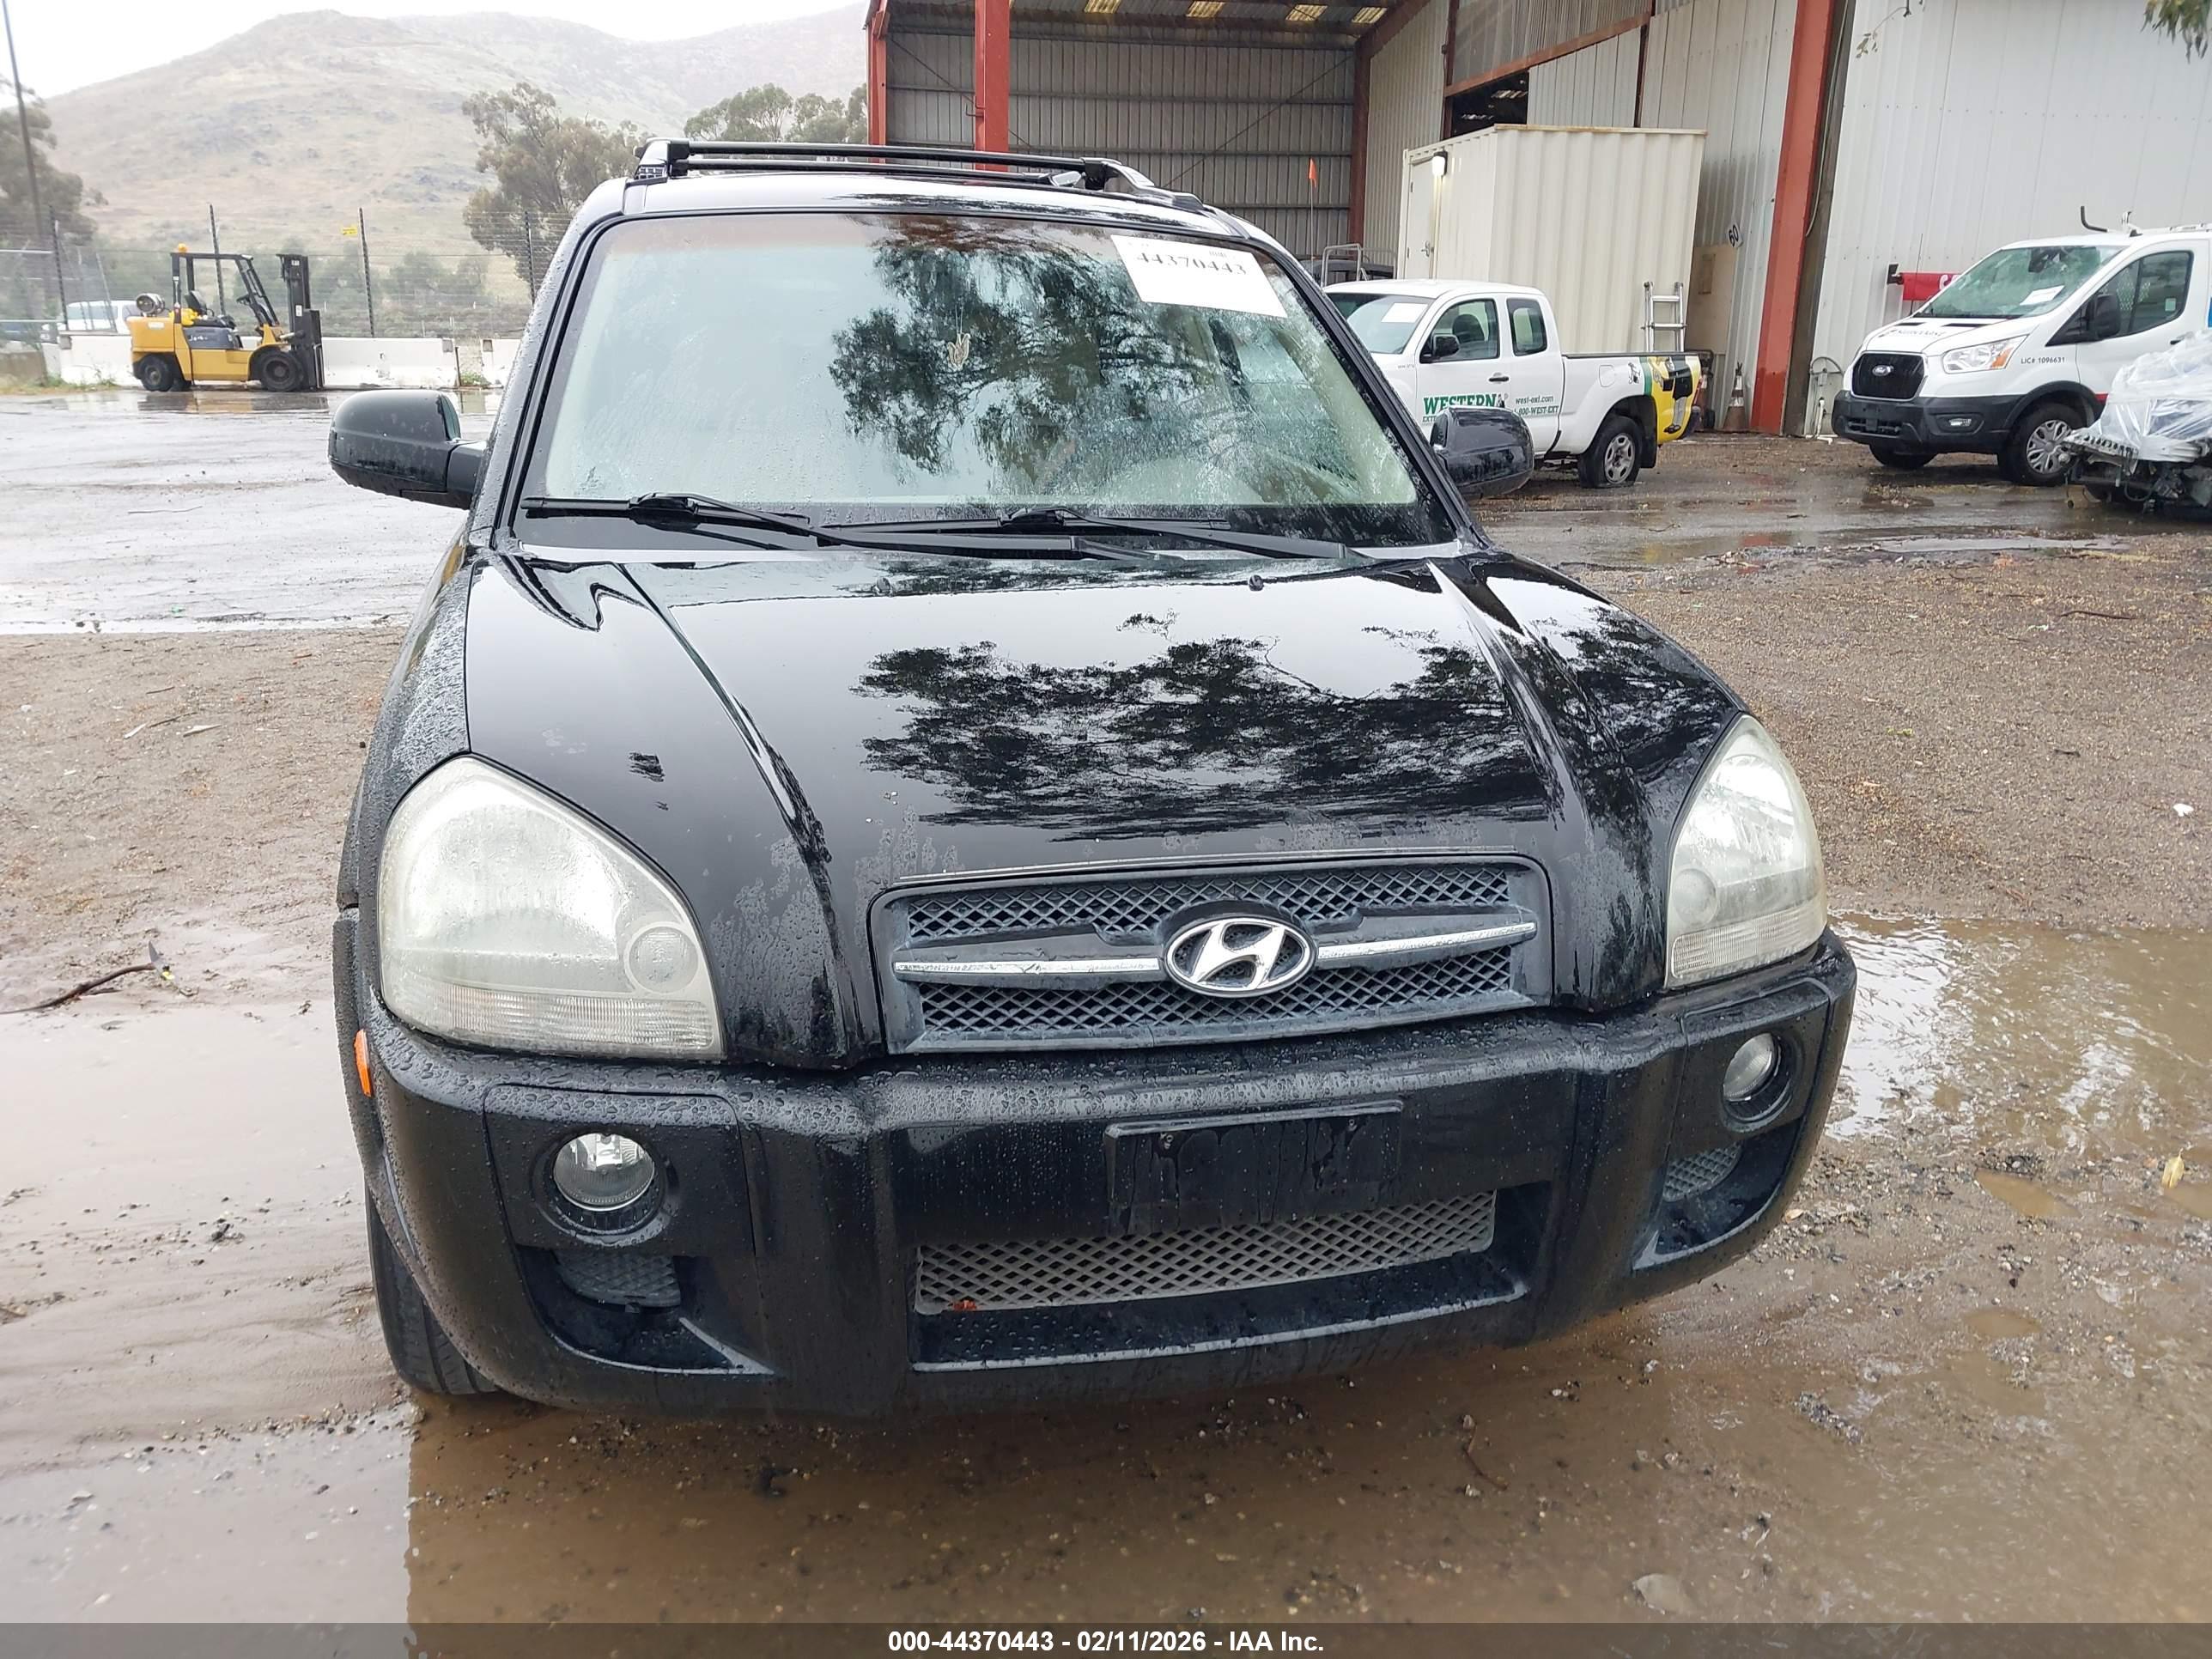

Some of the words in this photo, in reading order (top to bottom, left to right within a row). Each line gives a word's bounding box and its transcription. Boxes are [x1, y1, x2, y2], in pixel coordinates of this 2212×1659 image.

[1729, 224, 1739, 248] 60
[1136, 252, 1247, 275] 44370443
[1423, 393, 1497, 415] WESTERN
